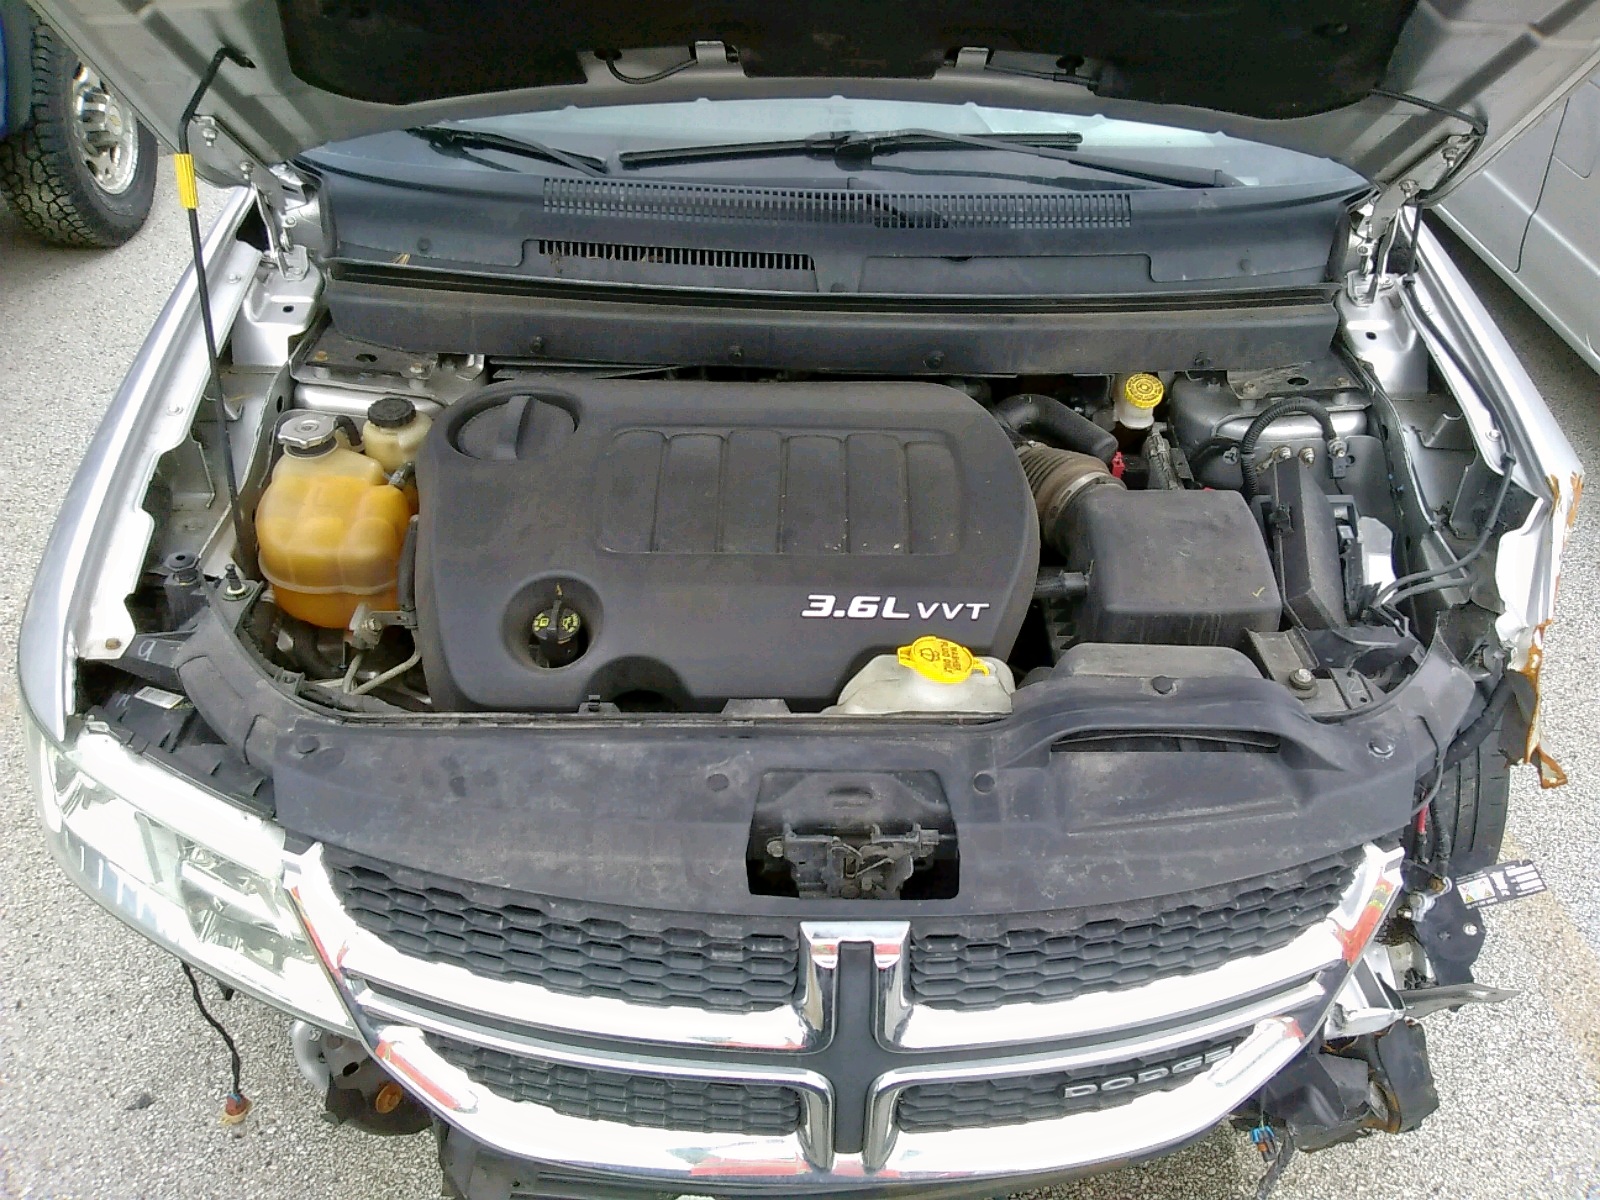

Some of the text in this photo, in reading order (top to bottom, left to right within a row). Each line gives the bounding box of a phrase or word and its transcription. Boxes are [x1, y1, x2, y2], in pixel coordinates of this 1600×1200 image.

[801, 594, 990, 620] 3.6L VVT
[1064, 1045, 1233, 1098] DODGE
